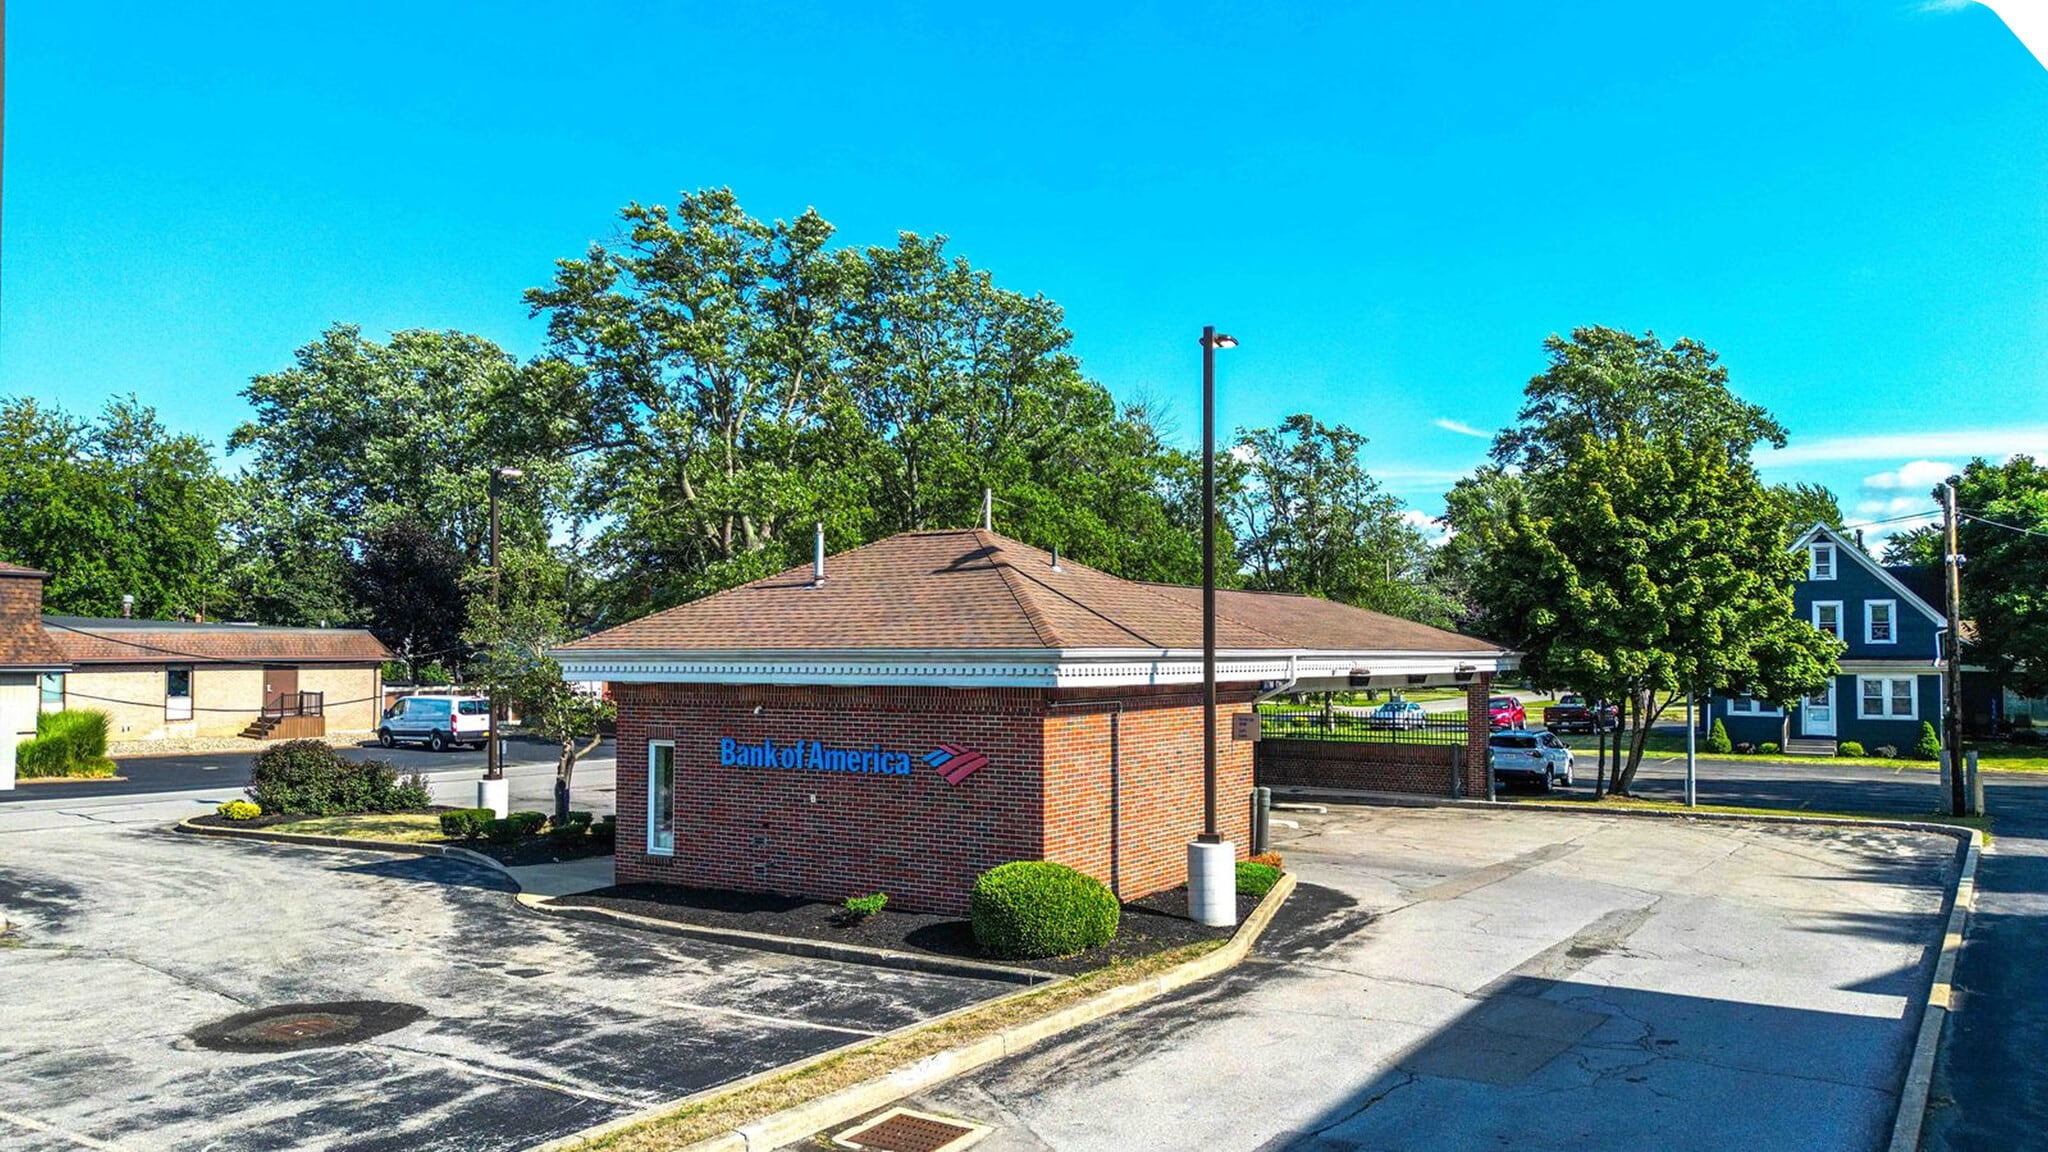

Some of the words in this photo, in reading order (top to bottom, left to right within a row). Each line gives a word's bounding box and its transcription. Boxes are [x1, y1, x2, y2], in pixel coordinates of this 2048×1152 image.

[720, 738, 778, 769] Bank
[780, 740, 805, 769] of
[807, 741, 911, 776] America
